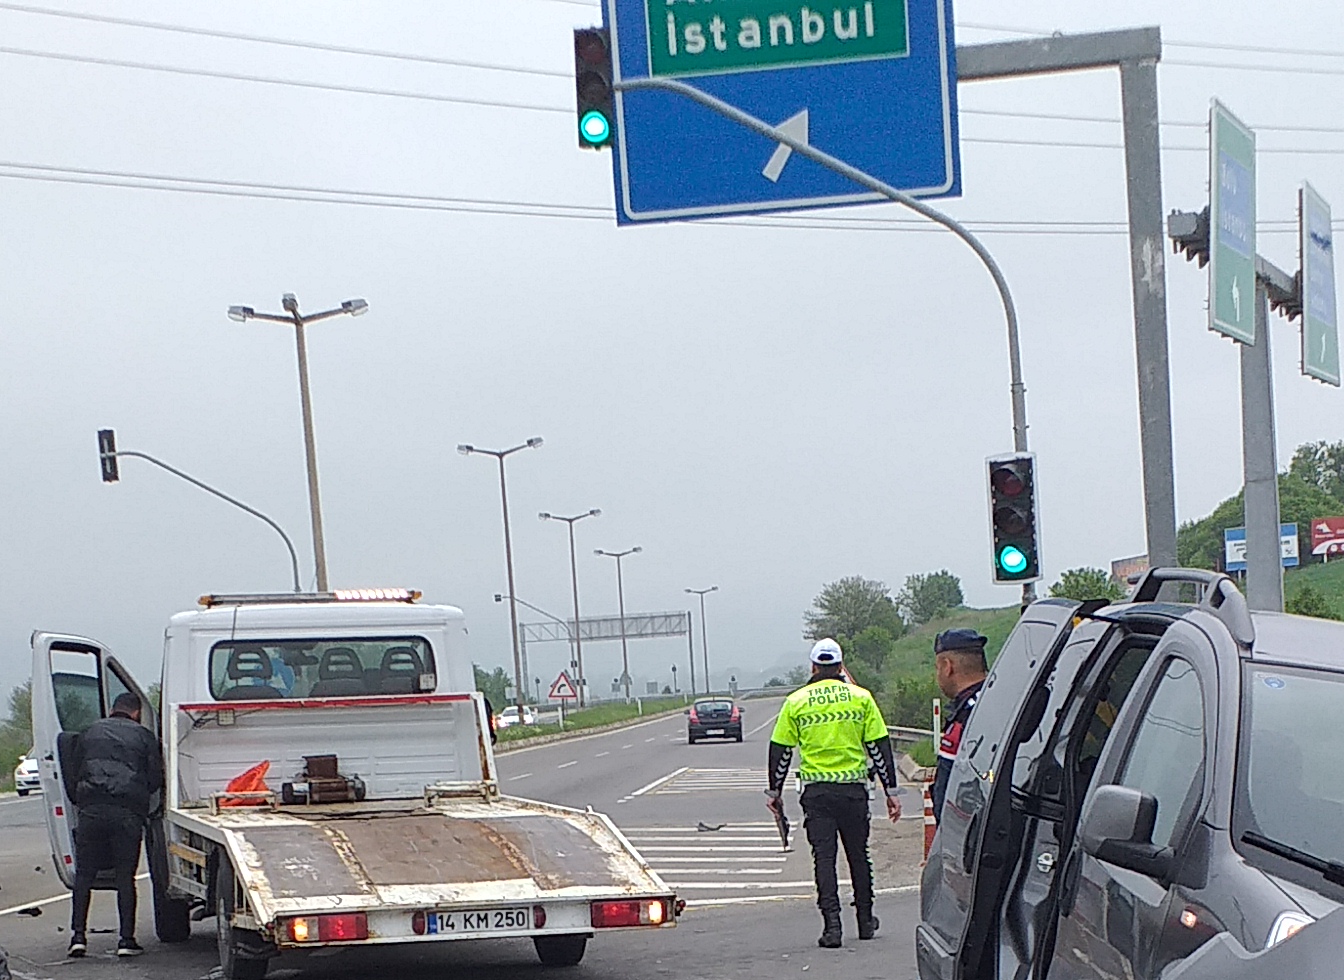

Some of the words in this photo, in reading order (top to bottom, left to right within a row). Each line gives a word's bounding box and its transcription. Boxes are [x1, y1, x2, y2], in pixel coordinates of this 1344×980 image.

[666, 1, 875, 56] İstanbul
[438, 914, 455, 931] 14
[463, 912, 489, 929] KM
[494, 911, 526, 928] 250
